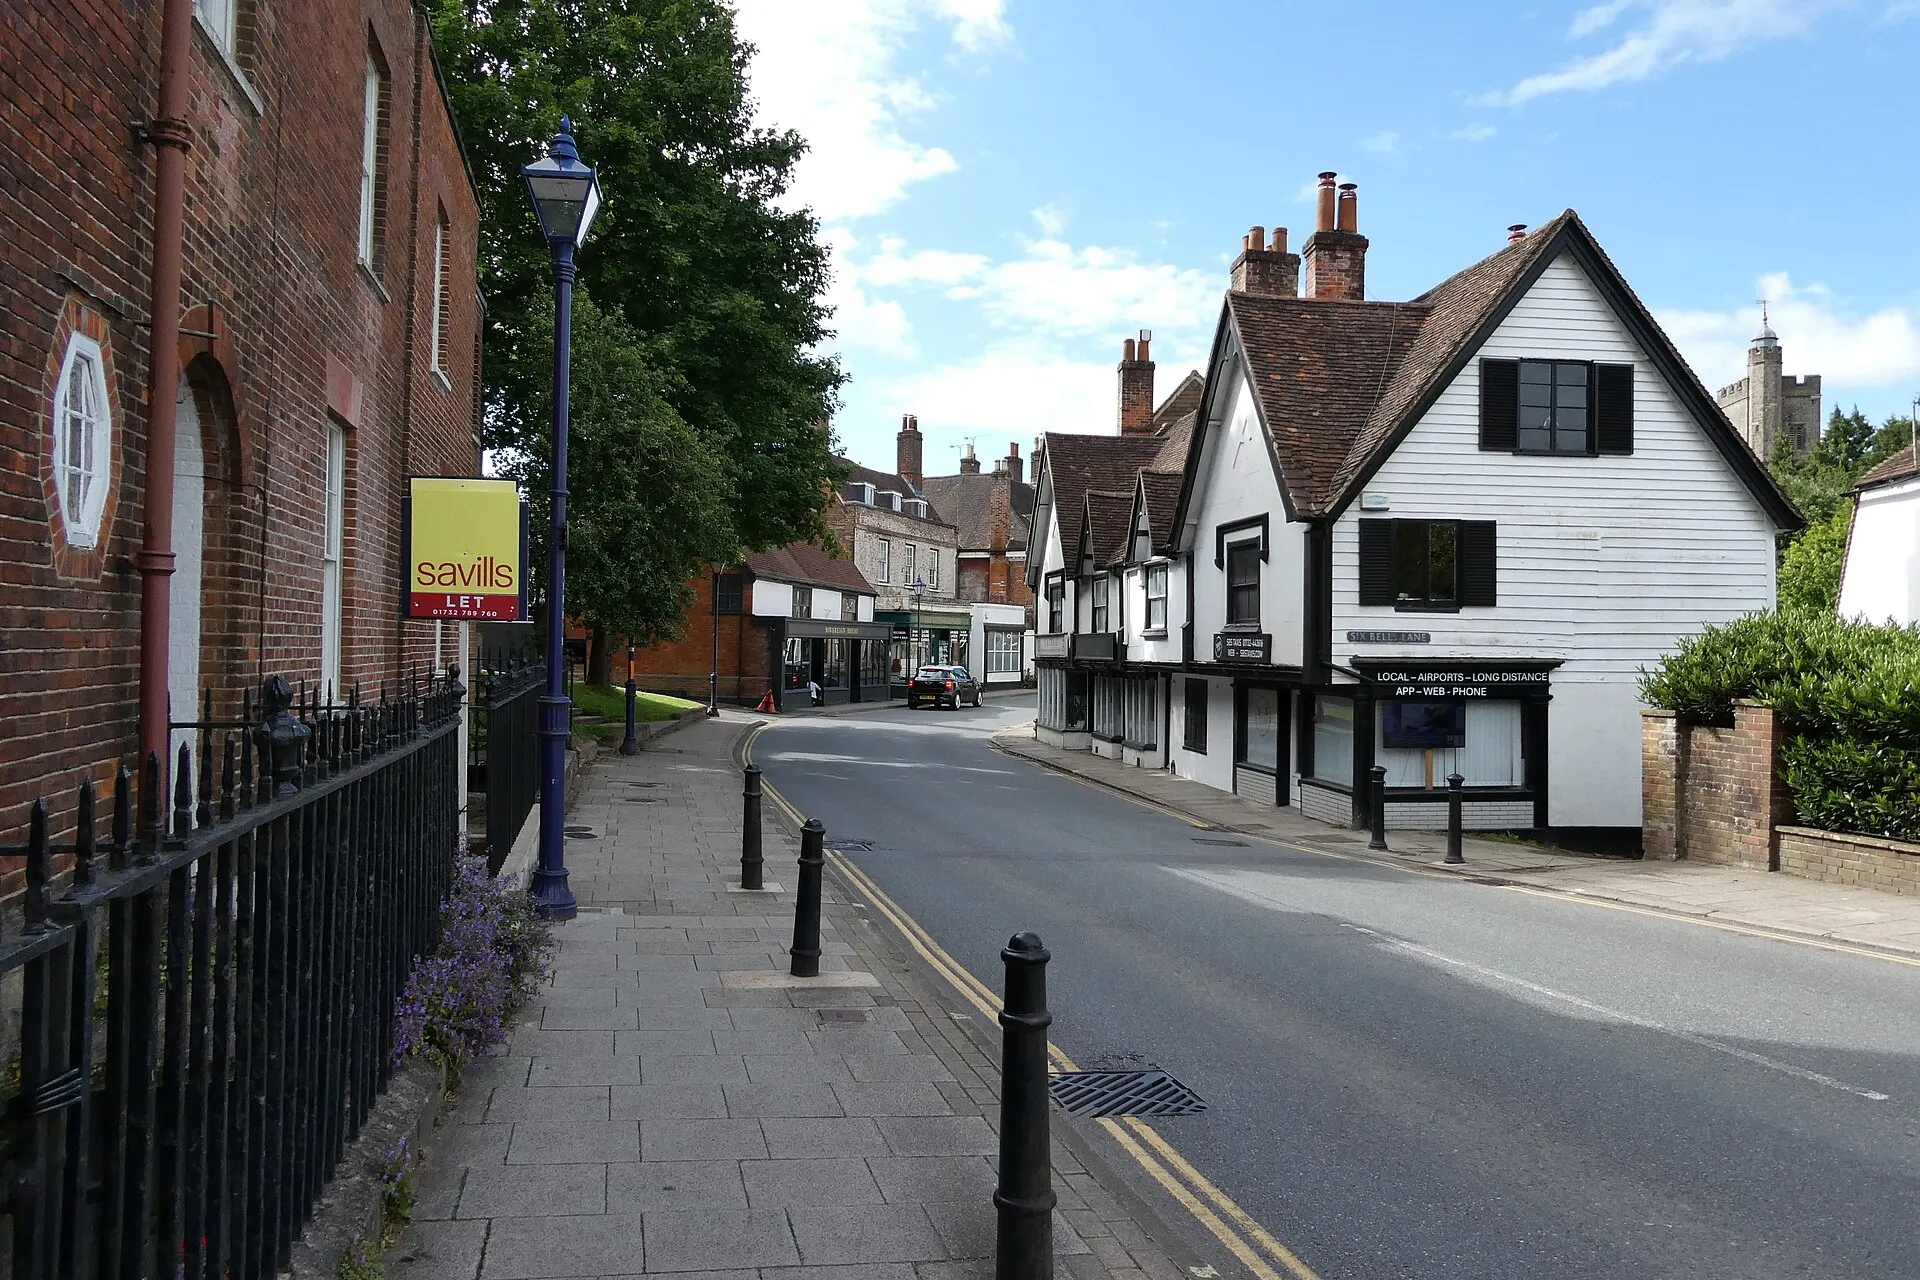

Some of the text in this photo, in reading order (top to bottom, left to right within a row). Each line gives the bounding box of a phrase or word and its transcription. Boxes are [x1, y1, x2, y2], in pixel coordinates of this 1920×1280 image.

[416, 556, 513, 588] savills
[446, 595, 484, 609] LET
[432, 608, 458, 616] 01732
[461, 609, 478, 617] 789
[1350, 632, 1427, 642] SIX BELLS LANE
[1377, 672, 1409, 682] LOCAL
[1417, 672, 1464, 682] AIRPORTS
[1472, 672, 1500, 682] LONG
[1501, 672, 1548, 682] DISTANCE
[1395, 686, 1415, 696] APP
[1422, 686, 1446, 696] WEB
[1452, 687, 1487, 696] PHONE
